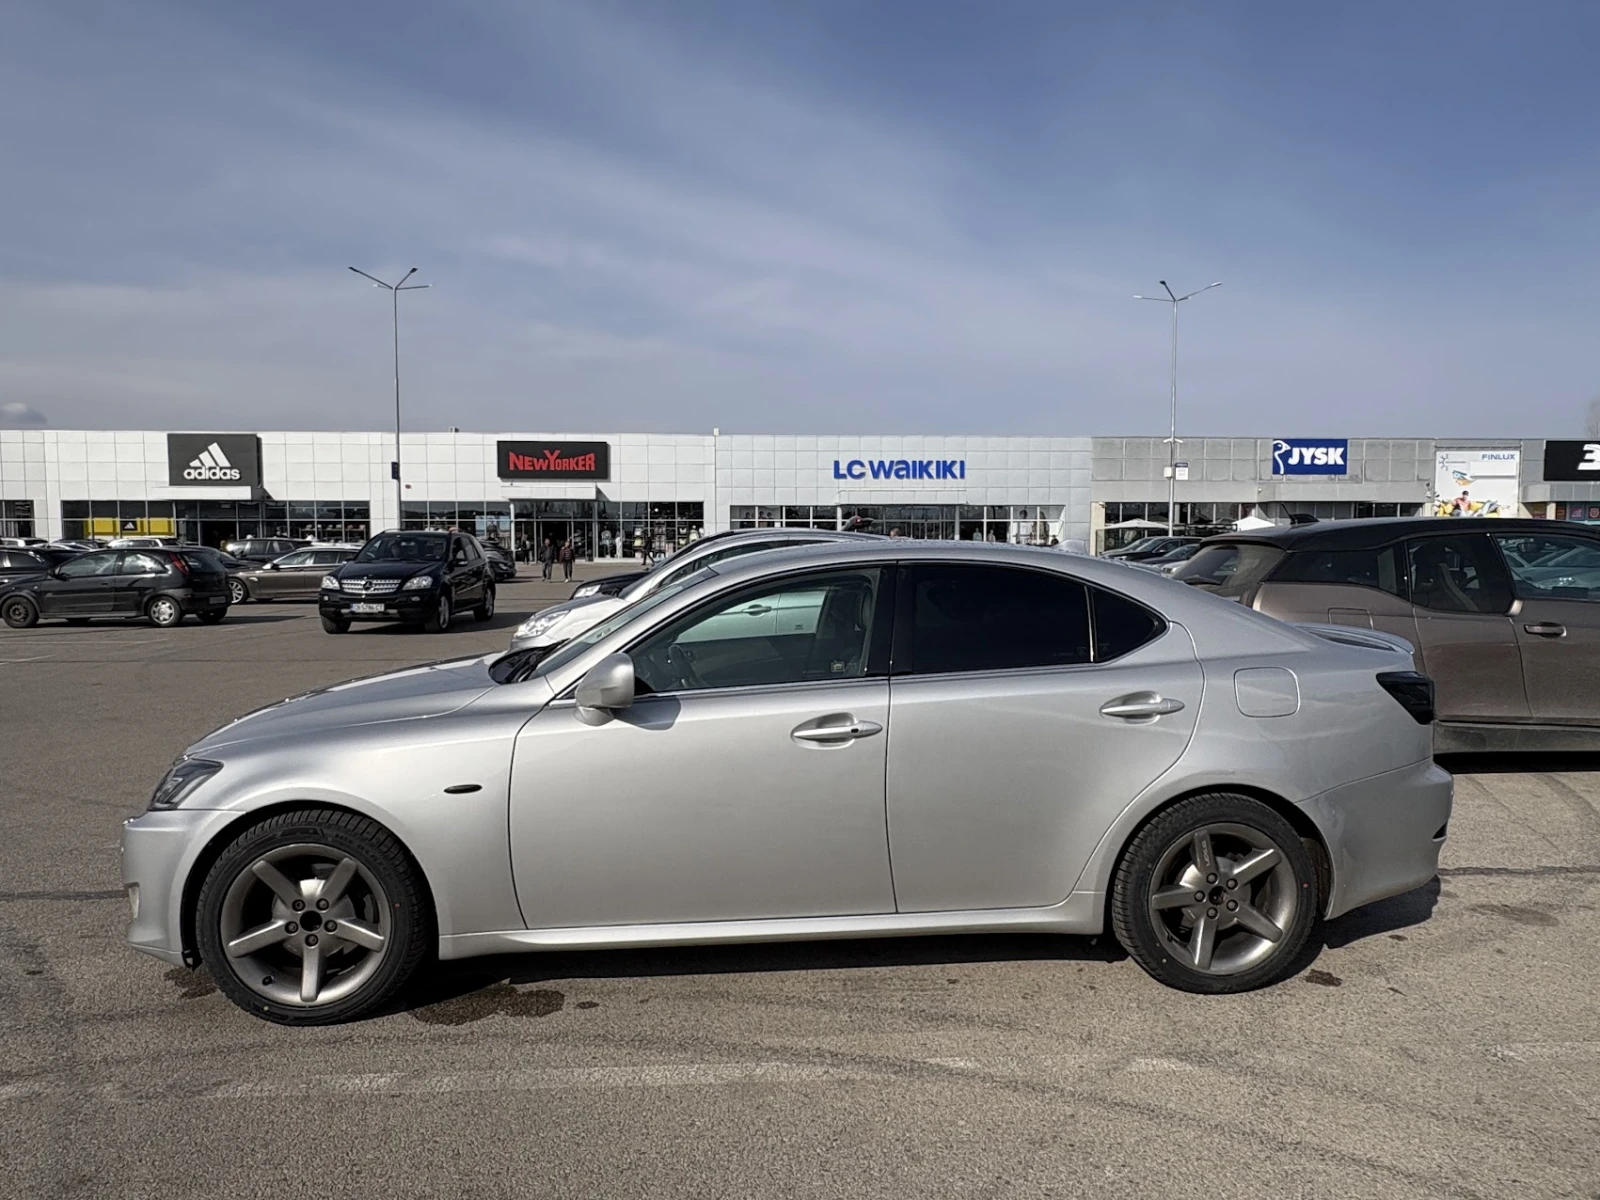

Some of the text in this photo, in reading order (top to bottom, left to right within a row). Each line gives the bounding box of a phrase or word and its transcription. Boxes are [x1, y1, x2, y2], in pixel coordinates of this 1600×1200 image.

[1288, 447, 1345, 465] JYSK
[1481, 453, 1516, 461] FINLUX
[183, 466, 241, 480] adidas
[833, 460, 866, 480] LC
